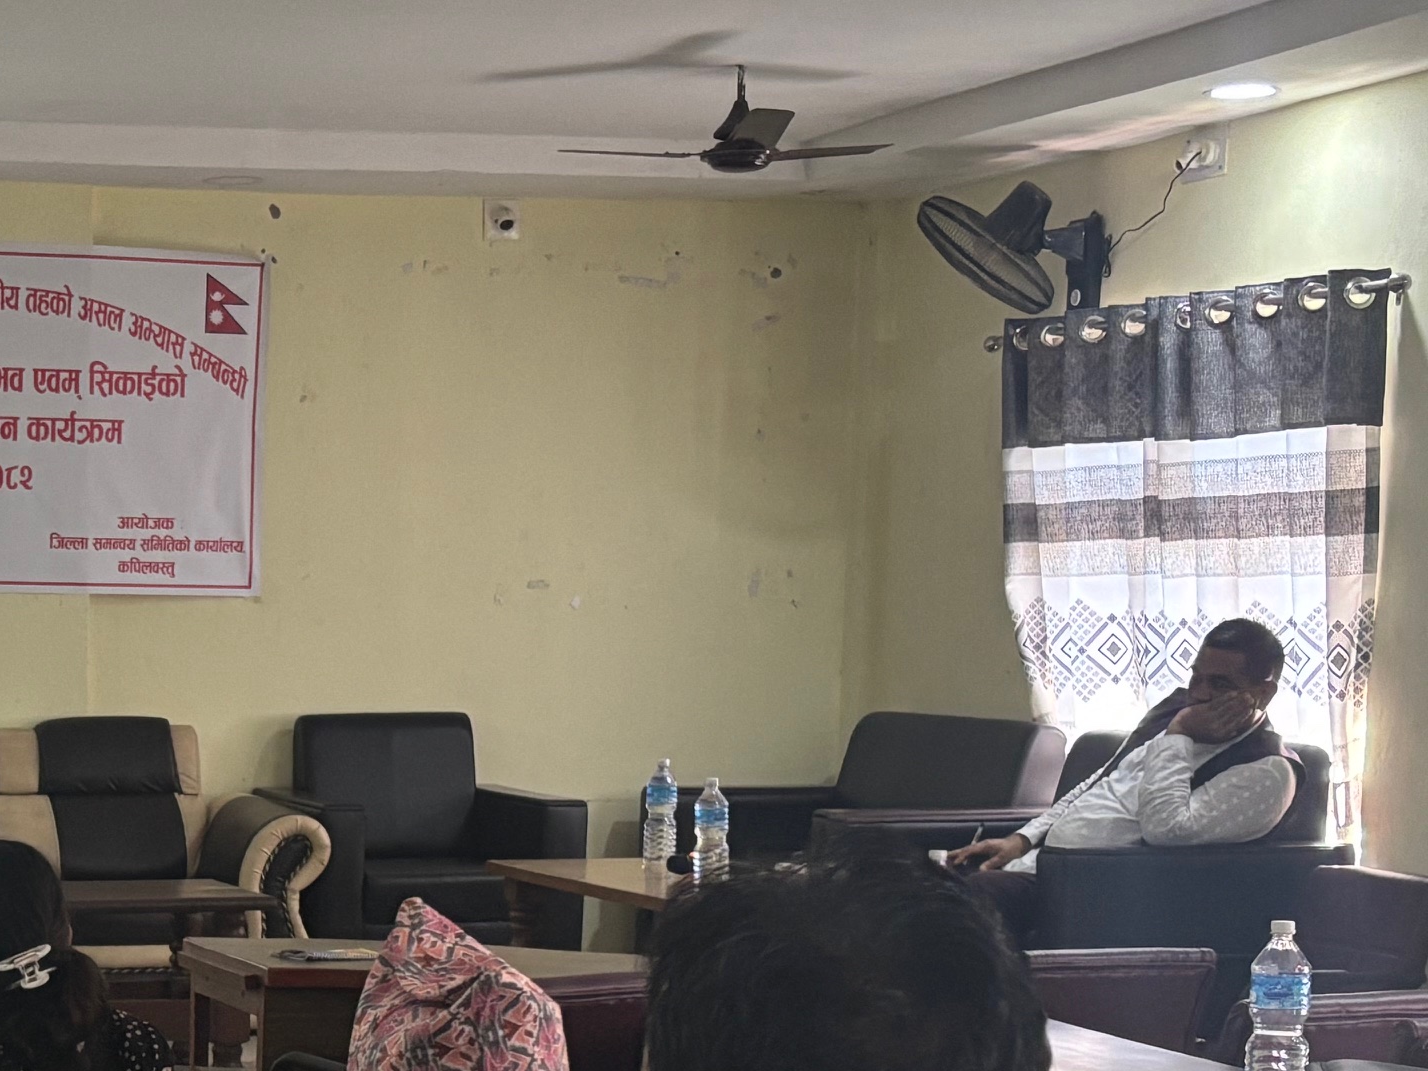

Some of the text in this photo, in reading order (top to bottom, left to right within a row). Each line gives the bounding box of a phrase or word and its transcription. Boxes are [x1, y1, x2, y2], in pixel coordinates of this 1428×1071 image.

[25, 285, 74, 318] तहको
[78, 295, 126, 333] असल
[128, 311, 187, 360] अभ्यास
[189, 341, 249, 400] सम्बन्धी
[33, 368, 82, 400] एवम्
[89, 361, 187, 401] सिकाईको
[26, 410, 125, 445] कार्यक्रम
[117, 513, 176, 530] आयोजक
[49, 532, 89, 550] जिल्ला
[92, 537, 138, 551] समन्वय
[140, 535, 191, 553] समितिको
[117, 557, 176, 578] कपिलवस्तु
